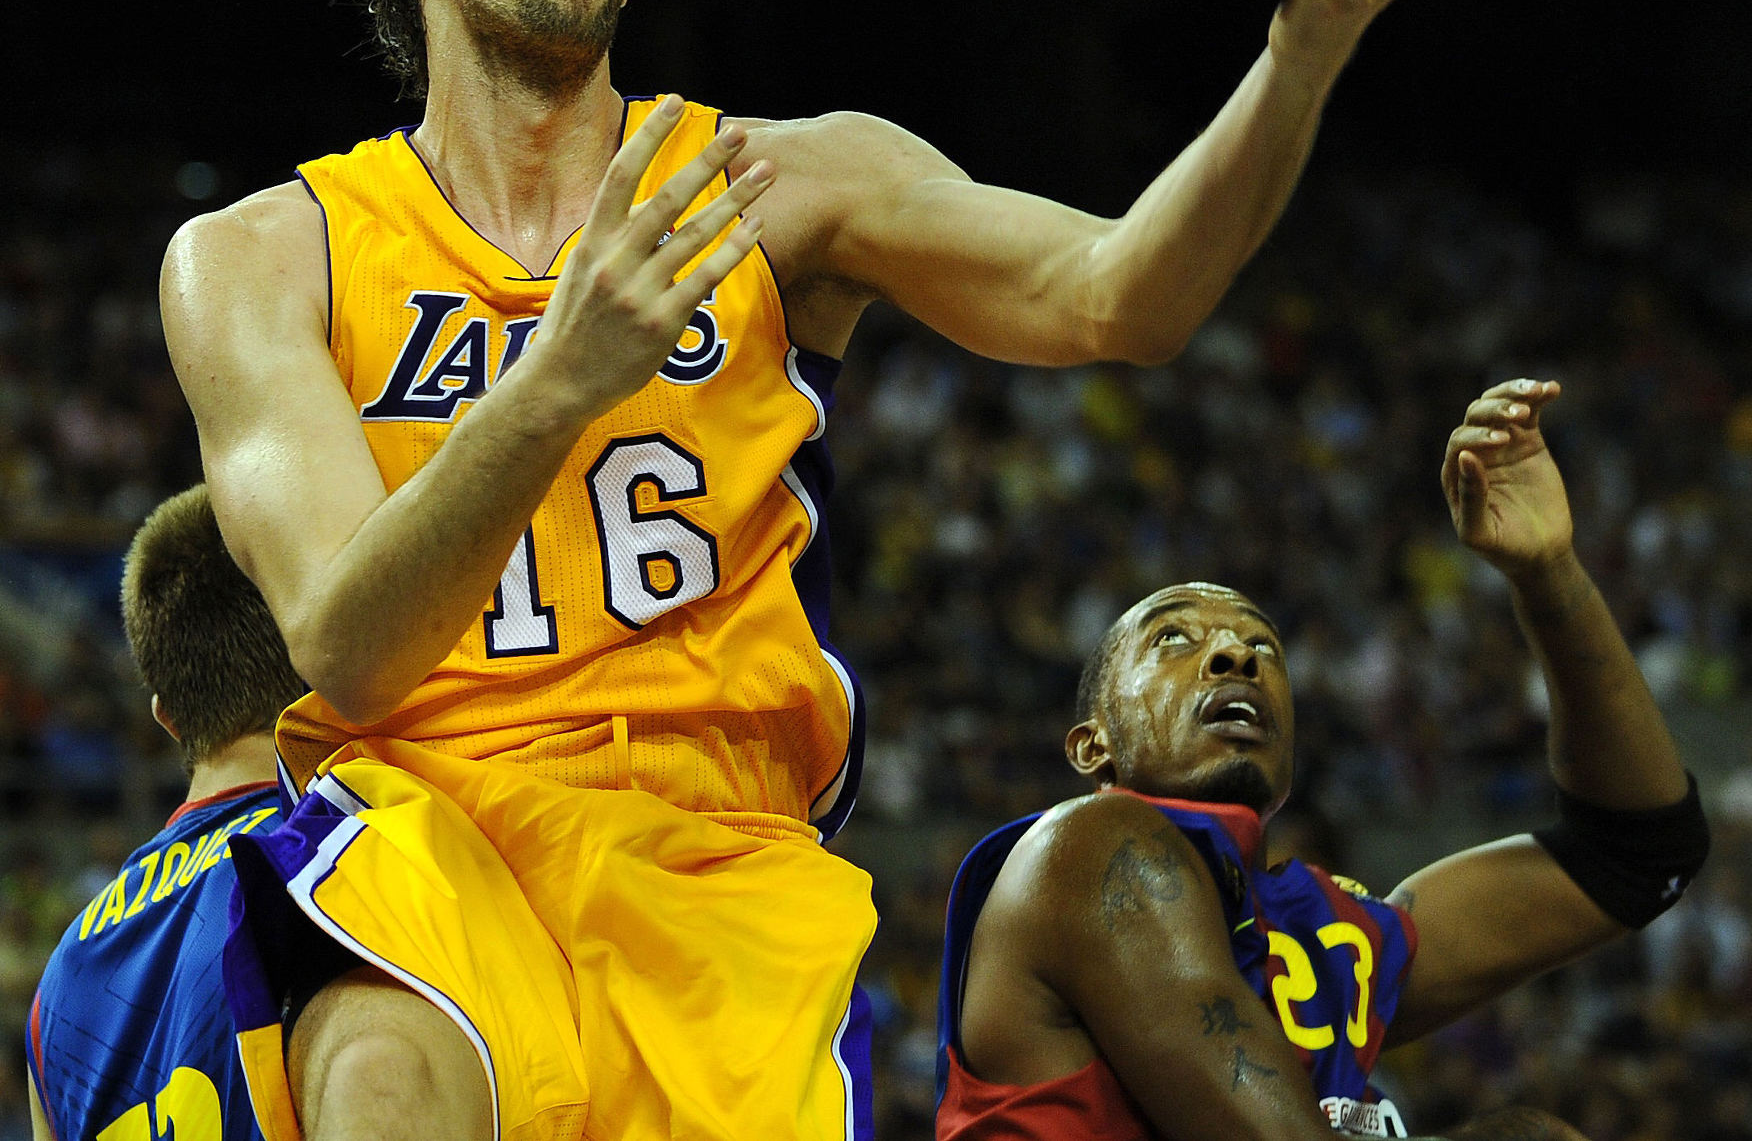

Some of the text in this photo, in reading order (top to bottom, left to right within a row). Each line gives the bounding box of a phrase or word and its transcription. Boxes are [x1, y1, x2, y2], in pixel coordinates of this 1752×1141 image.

[483, 432, 721, 659] 16
[79, 806, 280, 941] VAZQUEZ
[1266, 921, 1374, 1050] 23
